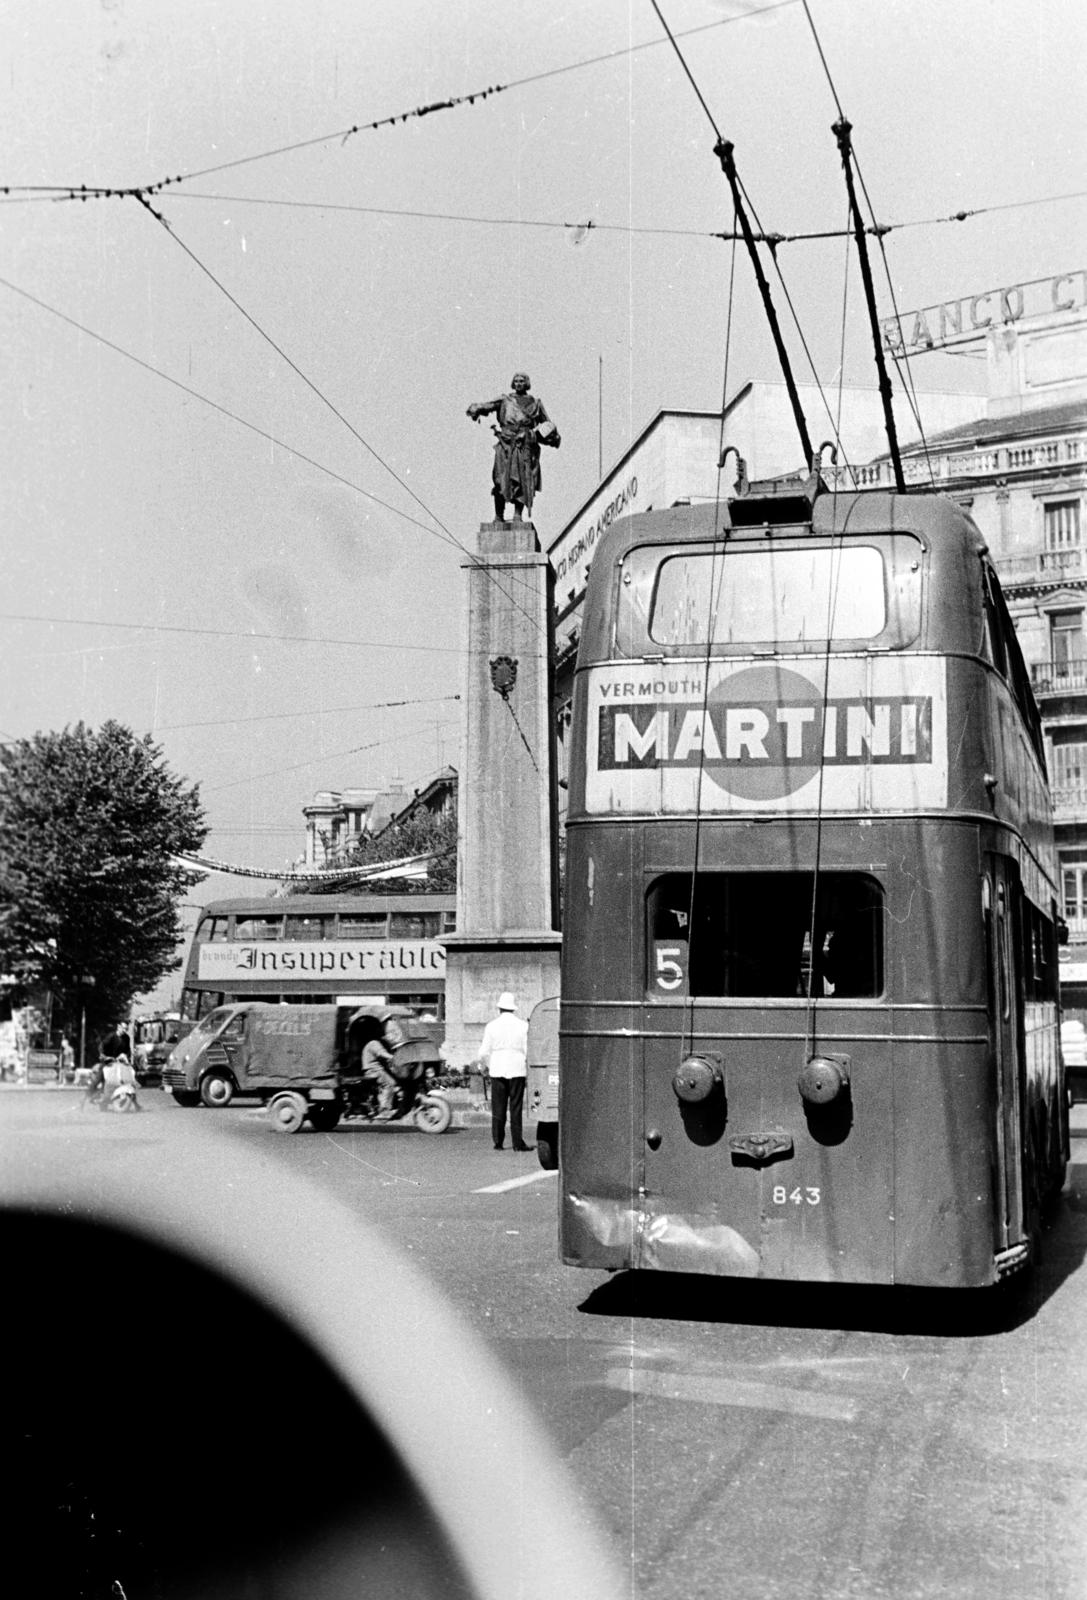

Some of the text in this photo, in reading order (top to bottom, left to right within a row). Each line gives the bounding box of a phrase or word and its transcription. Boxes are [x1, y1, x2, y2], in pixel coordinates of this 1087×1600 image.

[880, 270, 1087, 351] BANCO C
[597, 476, 638, 538] AMERICANO
[600, 679, 702, 698] VERMOUTH
[614, 704, 917, 763] MARTINI
[236, 947, 447, 973] Insuperable
[656, 948, 683, 990] 5
[773, 1185, 821, 1206] 843
